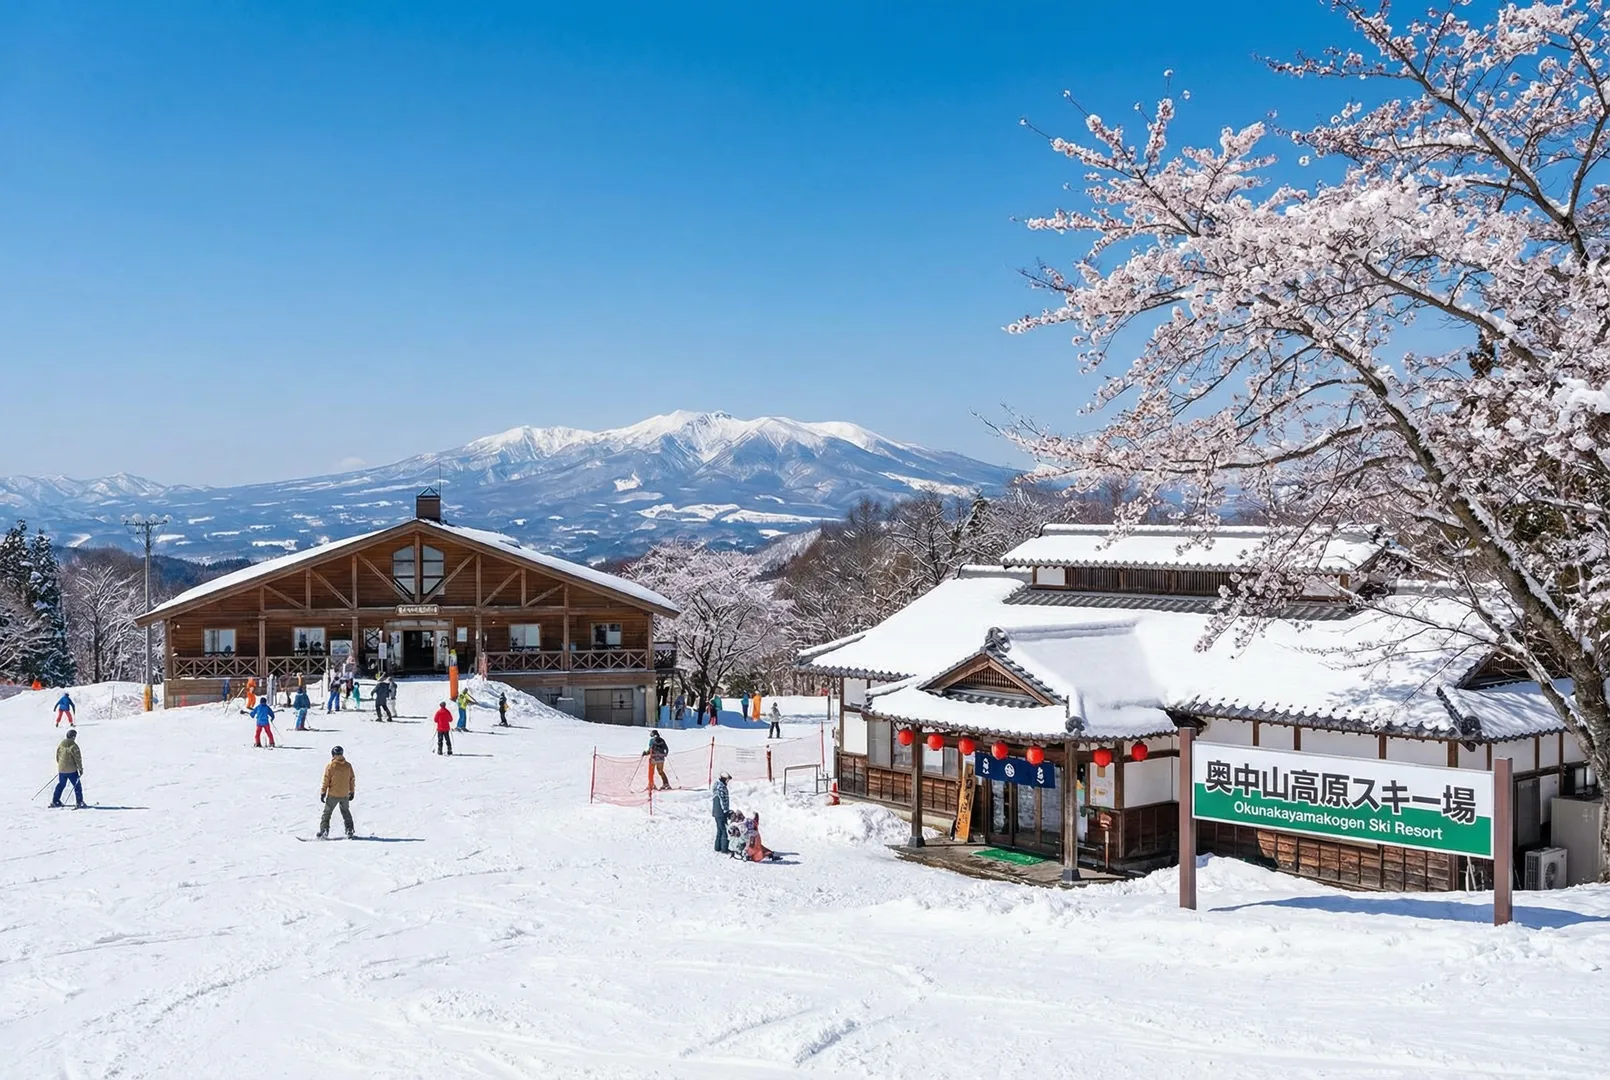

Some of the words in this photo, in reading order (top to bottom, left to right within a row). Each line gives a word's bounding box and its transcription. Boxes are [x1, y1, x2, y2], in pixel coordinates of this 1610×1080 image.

[1205, 760, 1476, 823] 奥中山高原スキー場
[1234, 801, 1365, 830] Okunakayamakogen
[1369, 818, 1391, 833] Ski
[1395, 821, 1443, 840] Resort
